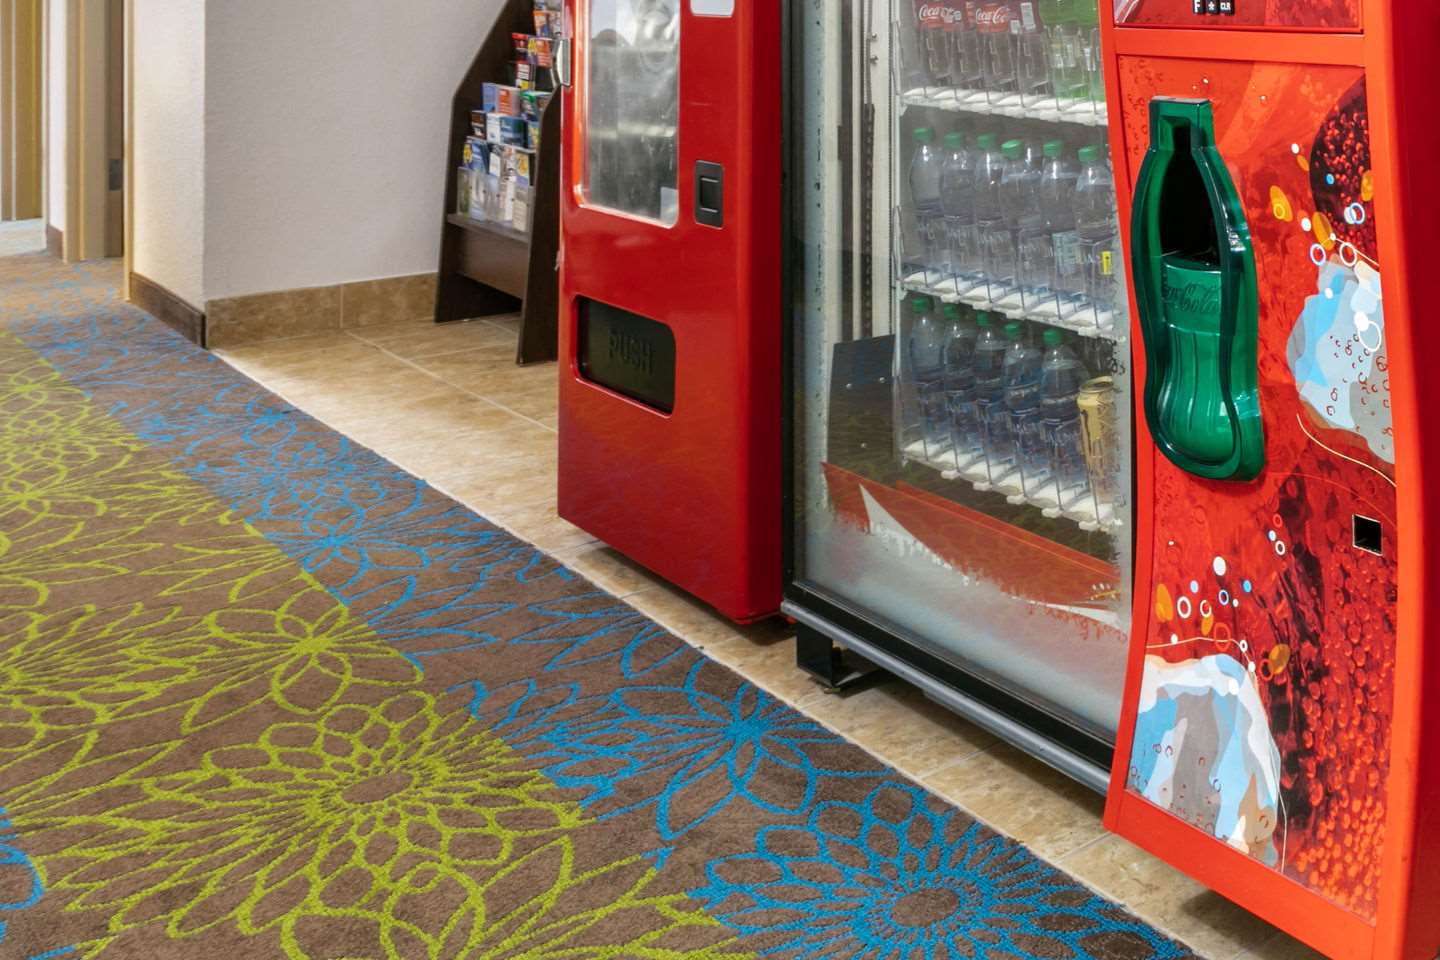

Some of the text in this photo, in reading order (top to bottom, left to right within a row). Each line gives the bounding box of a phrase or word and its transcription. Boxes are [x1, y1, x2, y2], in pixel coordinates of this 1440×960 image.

[1194, 0, 1231, 13] F CLR
[608, 328, 654, 376] PUSH
